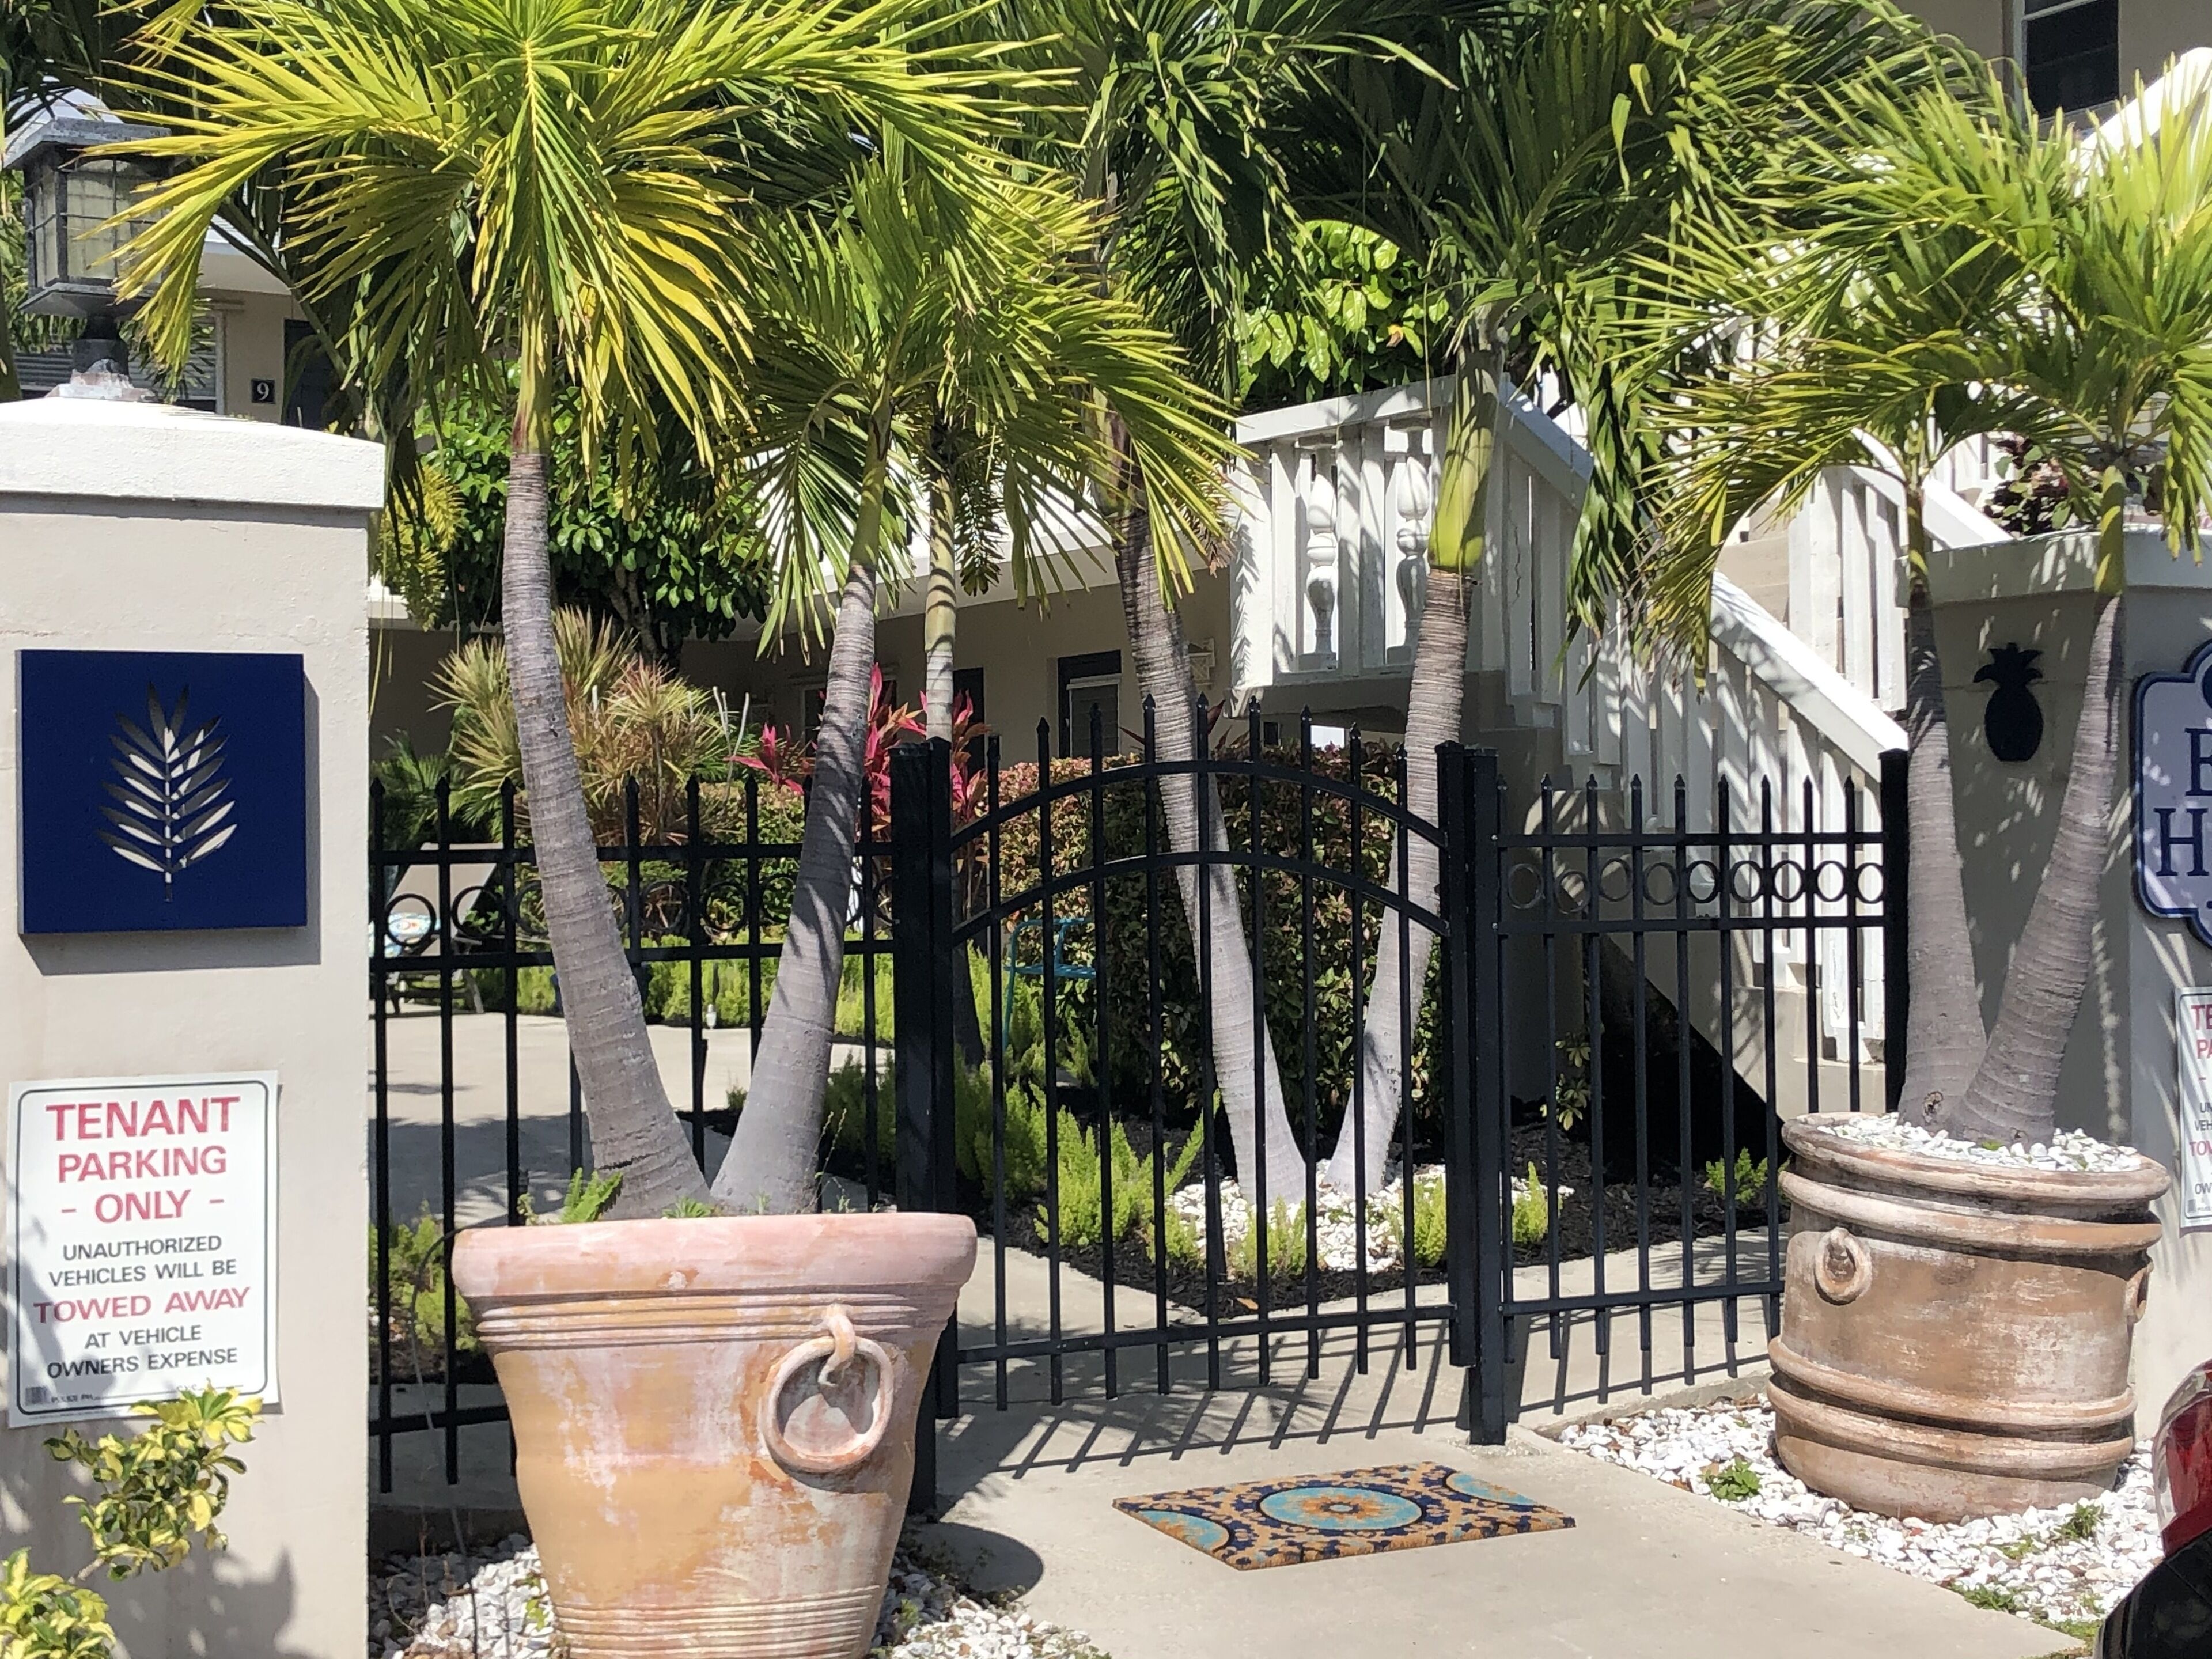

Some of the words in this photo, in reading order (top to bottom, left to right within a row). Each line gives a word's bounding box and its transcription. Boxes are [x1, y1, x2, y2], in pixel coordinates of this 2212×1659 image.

[257, 382, 269, 400] 9
[46, 1096, 240, 1141] TENANT
[58, 1145, 226, 1183] PARKING
[94, 1188, 191, 1223] ONLY
[63, 1234, 222, 1260] UNAUTHORIZED
[49, 1266, 145, 1286] VEHICLES
[155, 1262, 203, 1279] WILL
[213, 1259, 236, 1275] BE
[33, 1294, 151, 1324] TOWED
[164, 1286, 251, 1314] AWAY
[85, 1332, 110, 1349] AT
[119, 1325, 200, 1345] VEHICLE
[47, 1356, 139, 1378] OWNERS
[148, 1348, 237, 1370] EXPENSE
